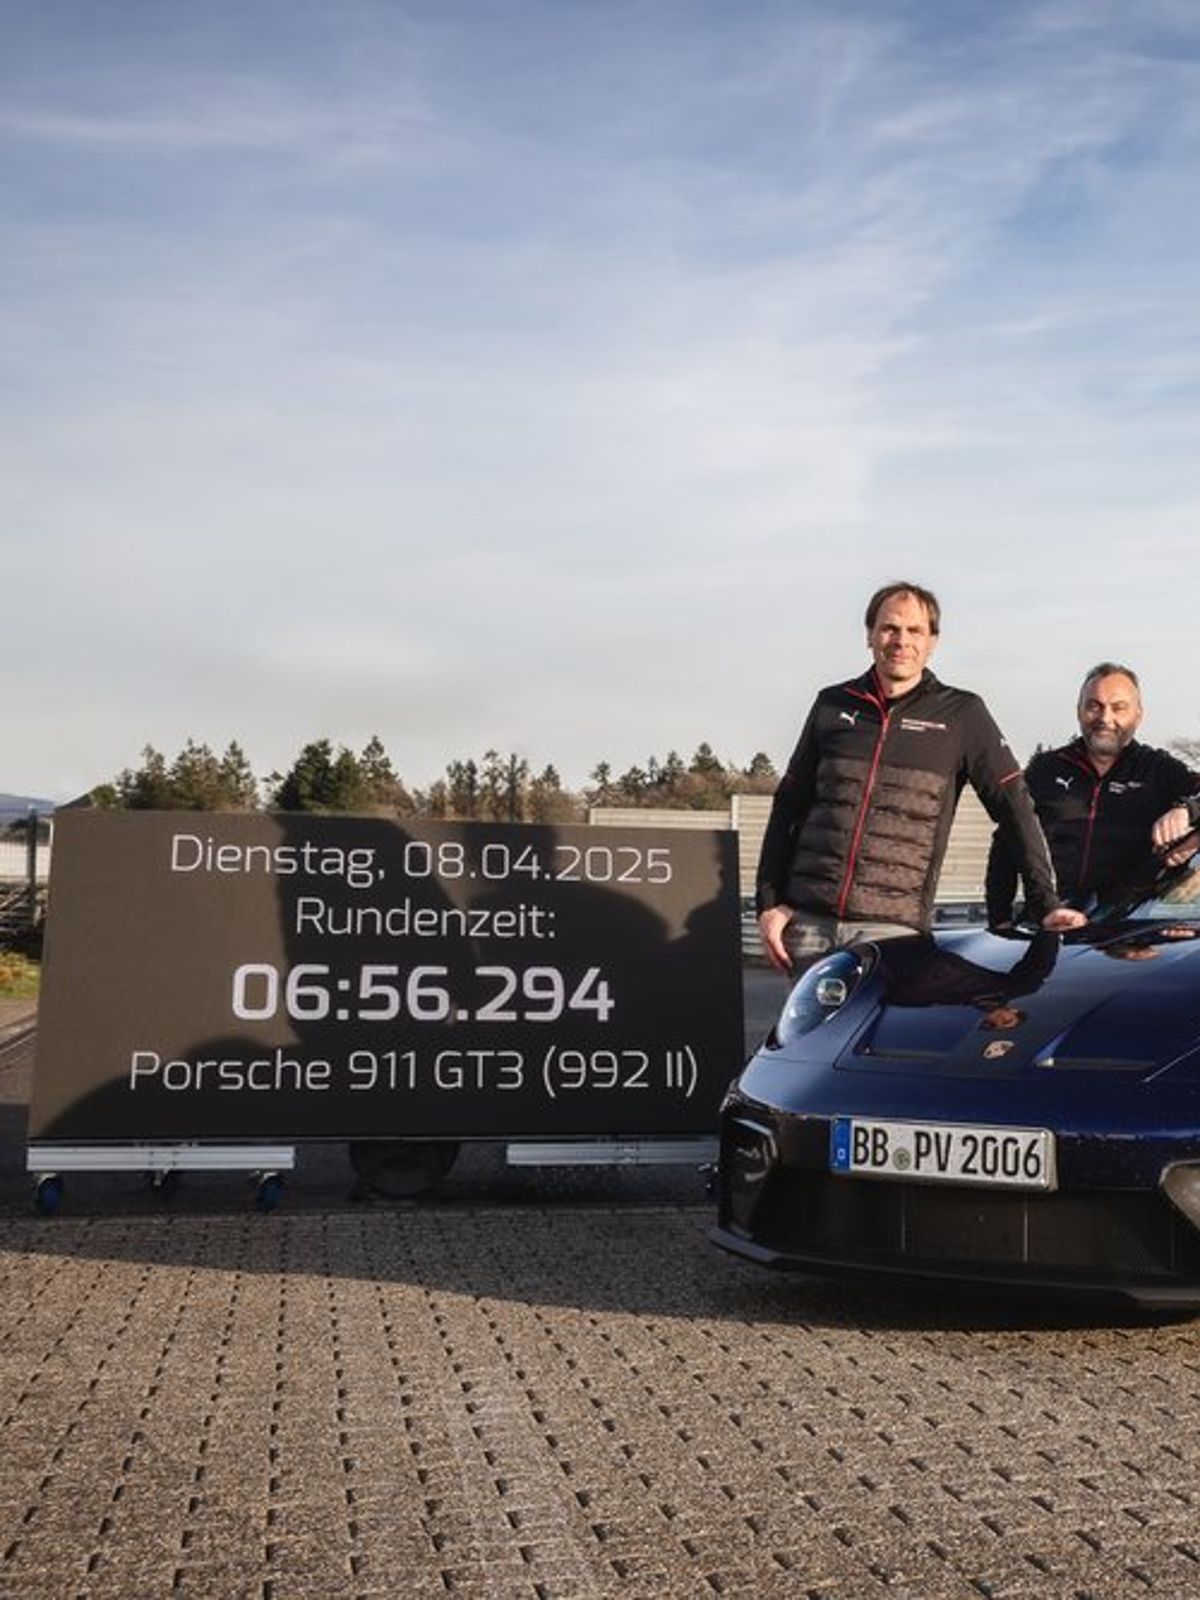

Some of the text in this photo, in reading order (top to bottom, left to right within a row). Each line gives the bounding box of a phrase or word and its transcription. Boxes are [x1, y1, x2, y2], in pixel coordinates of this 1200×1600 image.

[171, 834, 673, 888] Dienstag, 08.04.2025
[296, 897, 556, 938] Rundenzeit:
[231, 963, 615, 1021] 06:56.294
[131, 1049, 330, 1090] Porsche
[348, 1051, 416, 1089] 911
[434, 1050, 524, 1088] GT3
[543, 1045, 649, 1097] (992
[853, 1126, 1041, 1179] BB PV 2006
